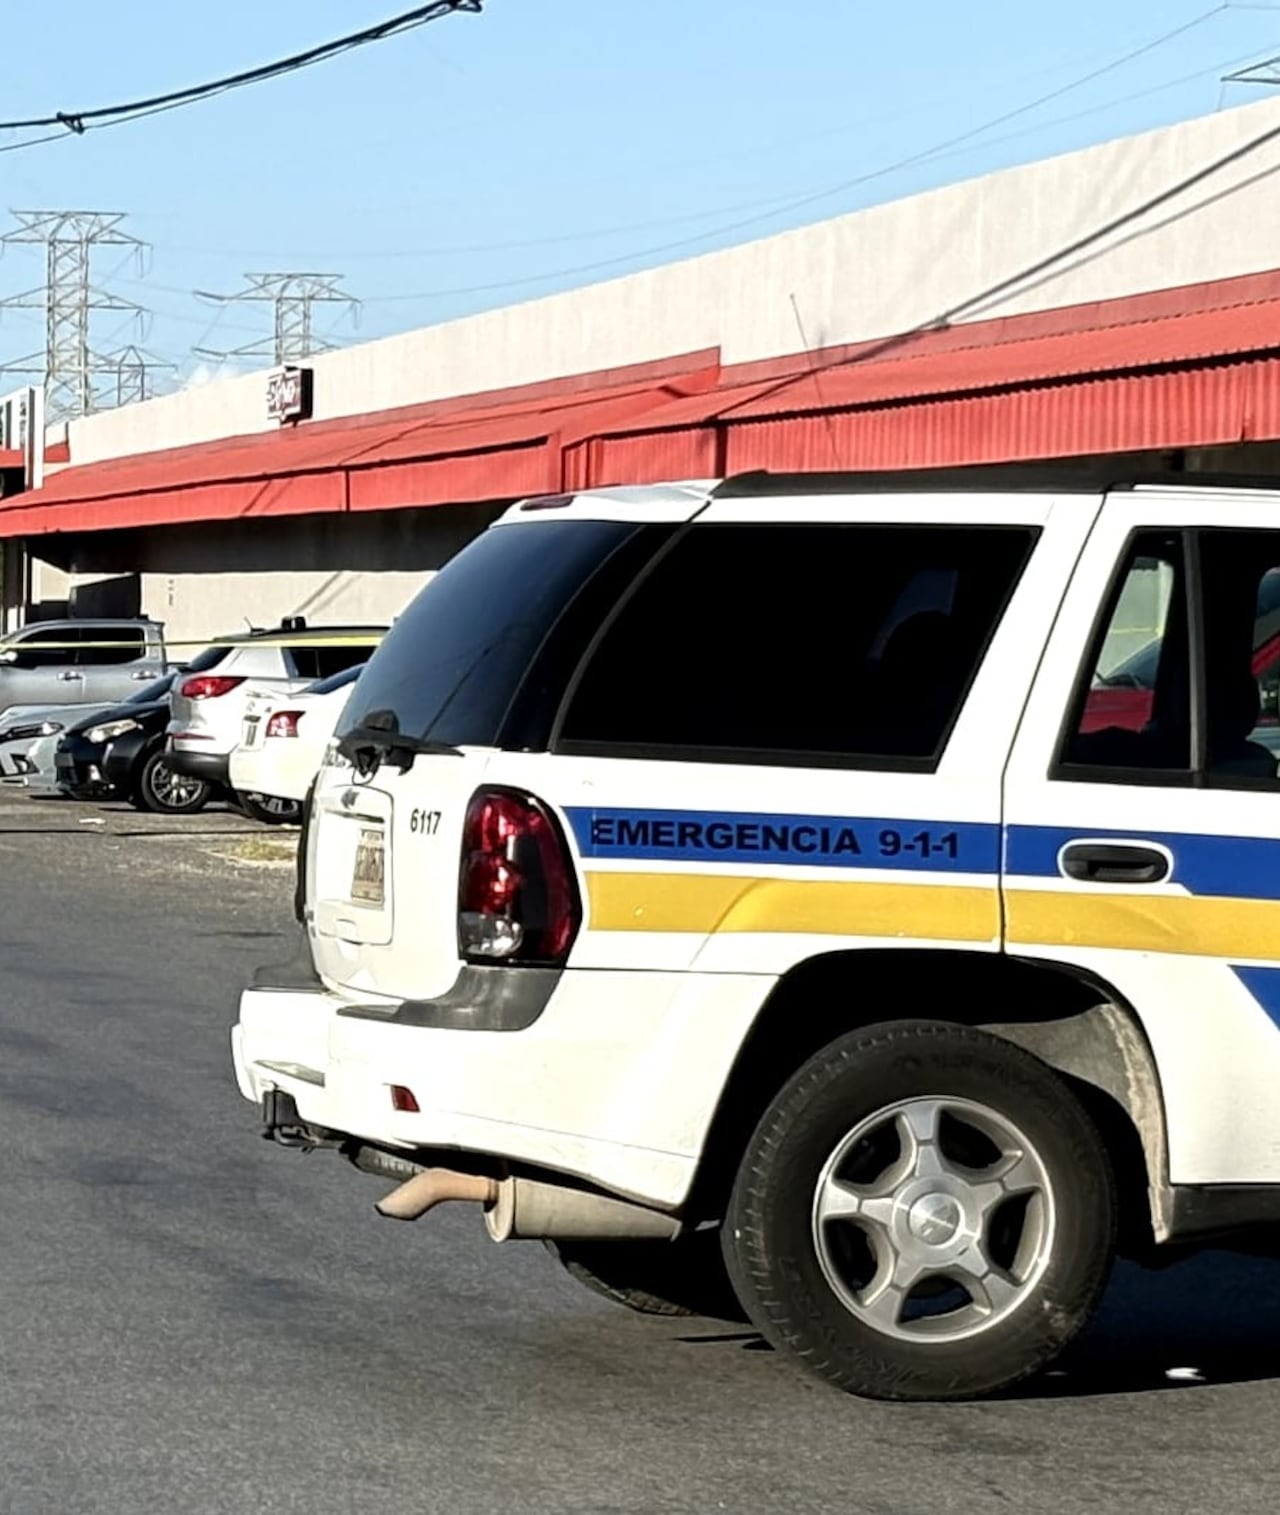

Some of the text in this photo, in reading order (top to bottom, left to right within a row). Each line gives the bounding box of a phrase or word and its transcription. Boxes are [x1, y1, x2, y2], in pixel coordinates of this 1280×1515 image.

[410, 808, 442, 835] 6117
[591, 818, 959, 859] EMERGENCIA 9-1-1
